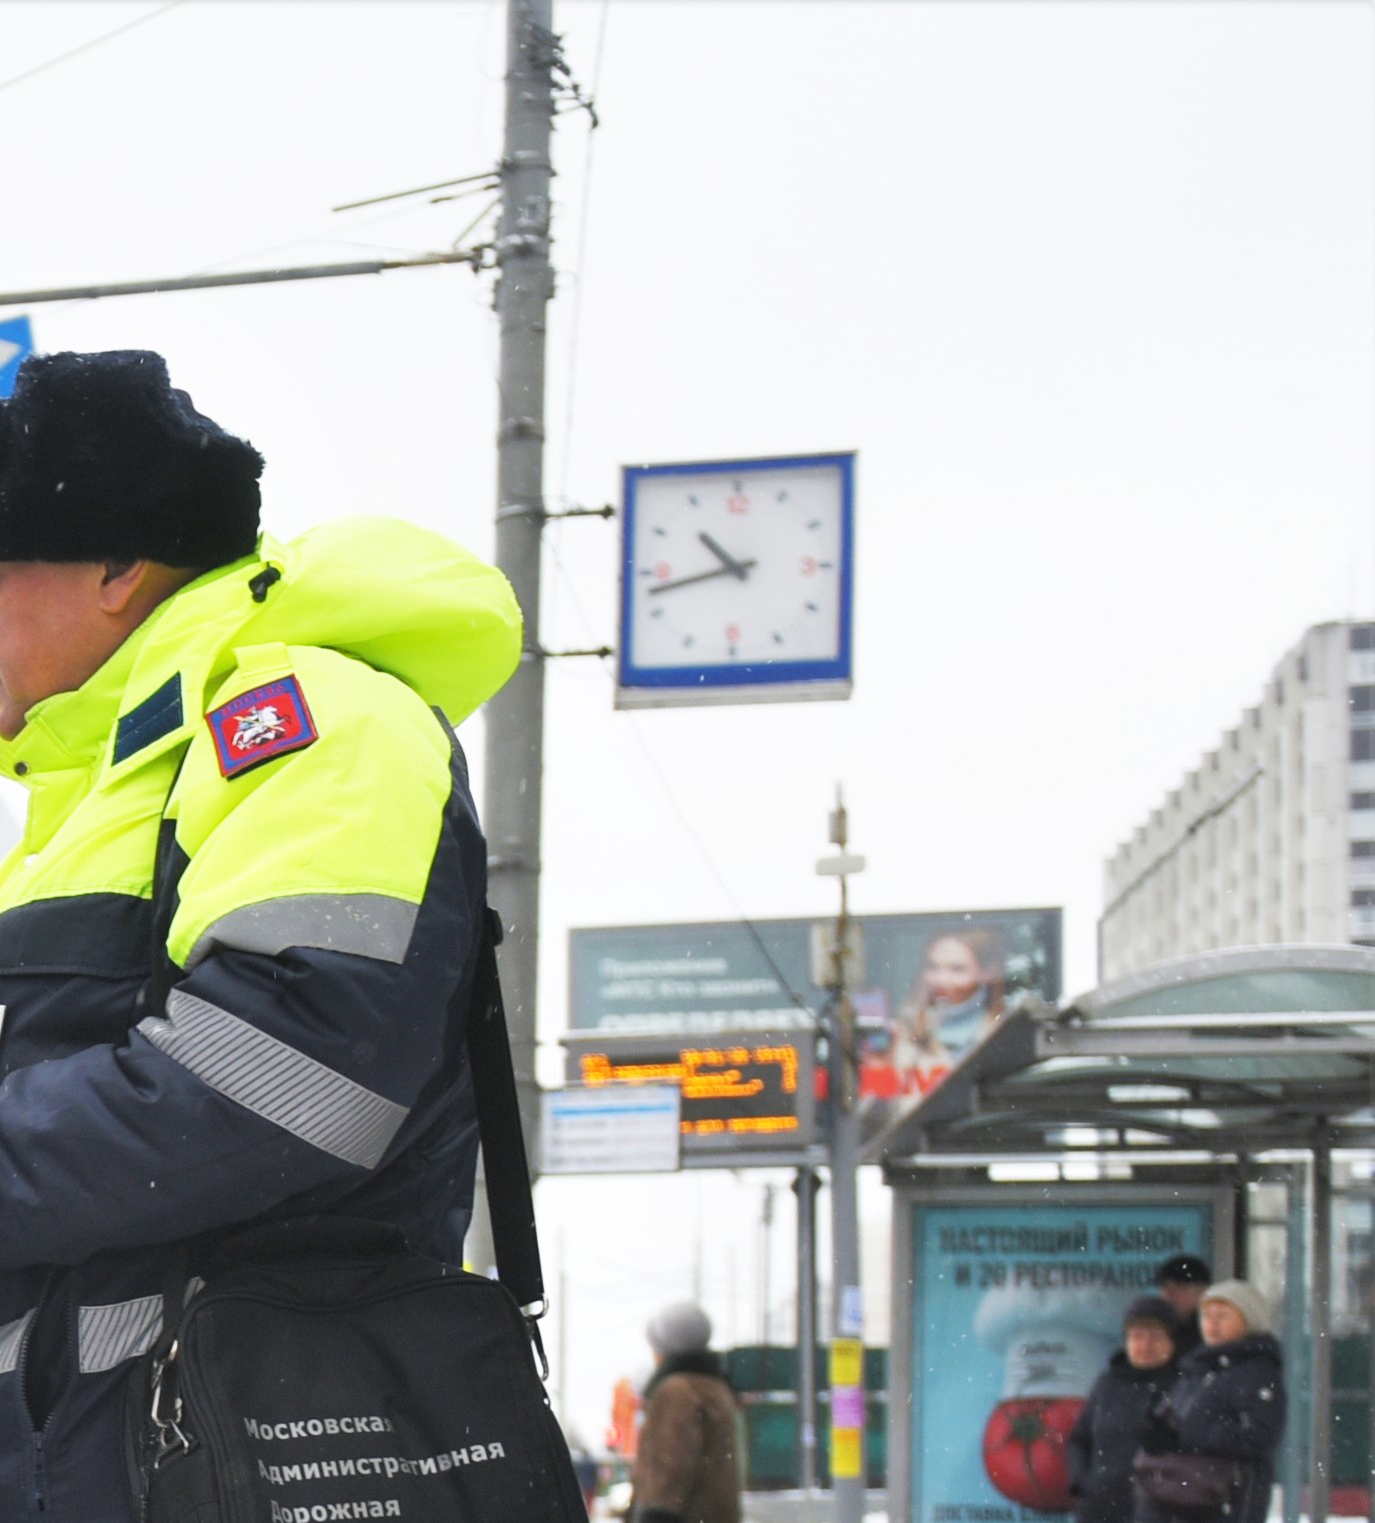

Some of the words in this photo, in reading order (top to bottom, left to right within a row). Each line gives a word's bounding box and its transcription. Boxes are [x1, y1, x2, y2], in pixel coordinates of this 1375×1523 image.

[1015, 1259, 1160, 1289] РЕСТОРАНО
[244, 1415, 395, 1441] Московская
[258, 1442, 506, 1486] Административная
